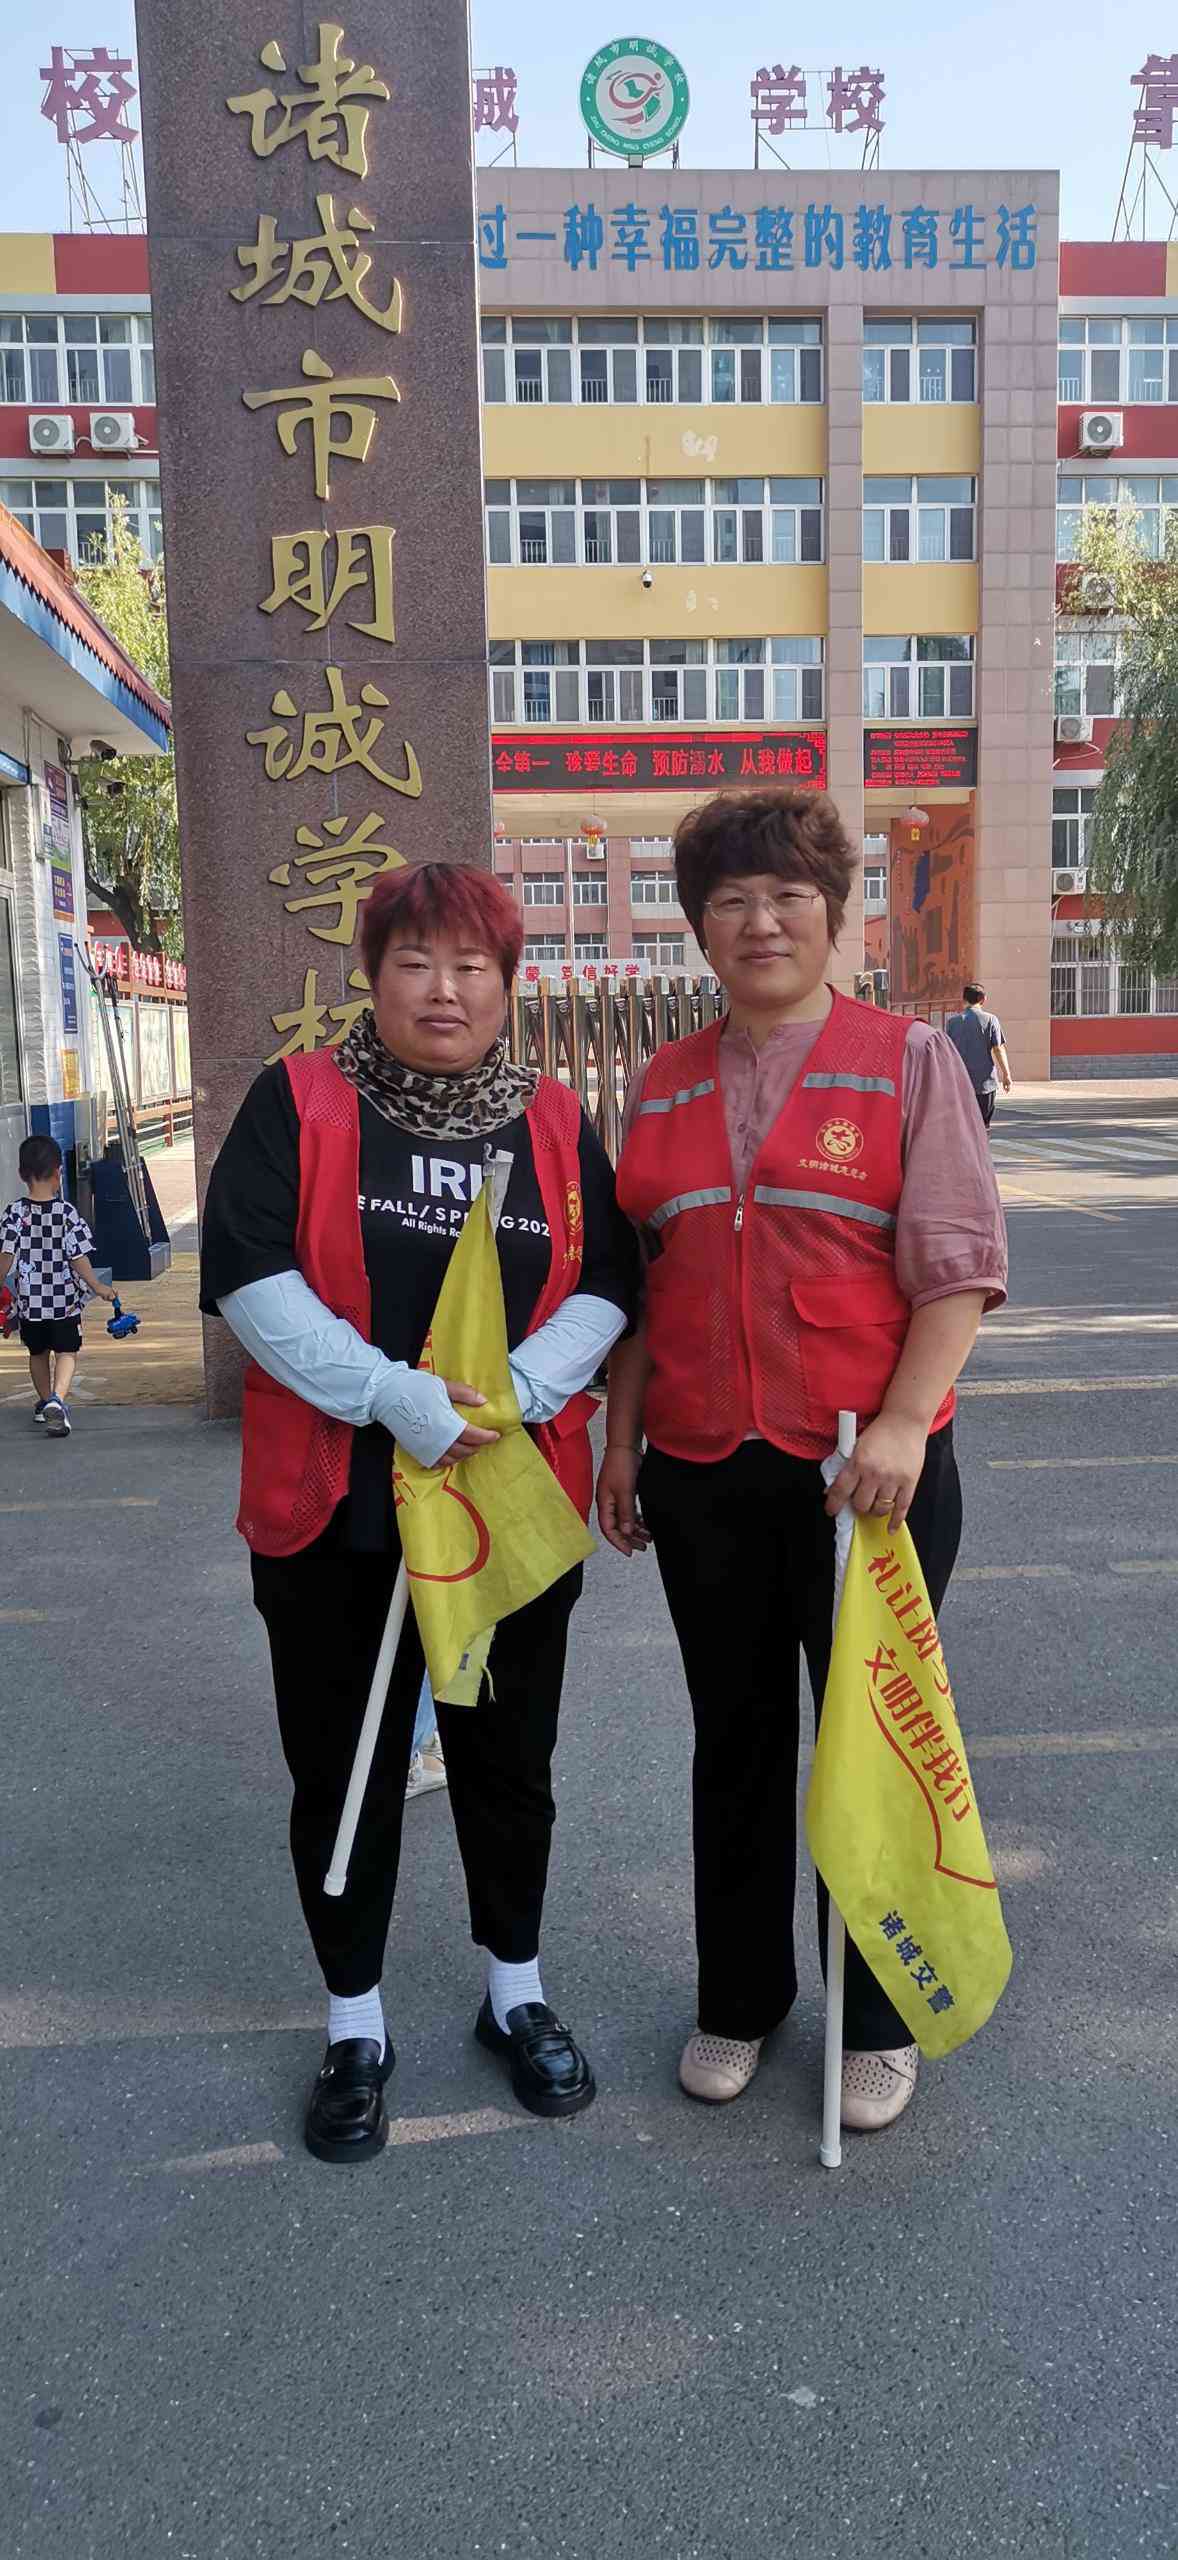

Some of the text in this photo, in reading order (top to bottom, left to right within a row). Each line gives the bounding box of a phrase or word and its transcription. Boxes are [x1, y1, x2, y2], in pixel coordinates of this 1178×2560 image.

[40, 46, 139, 143] 校
[751, 64, 886, 134] 学校
[478, 202, 1036, 272] 过一种幸福完整的教育生活
[653, 749, 725, 776] 预防溺水
[740, 748, 813, 775] 从我做起
[401, 1217, 416, 1229] All
[418, 1220, 447, 1236] Rights
[878, 1909, 955, 2015] 诸城交警
